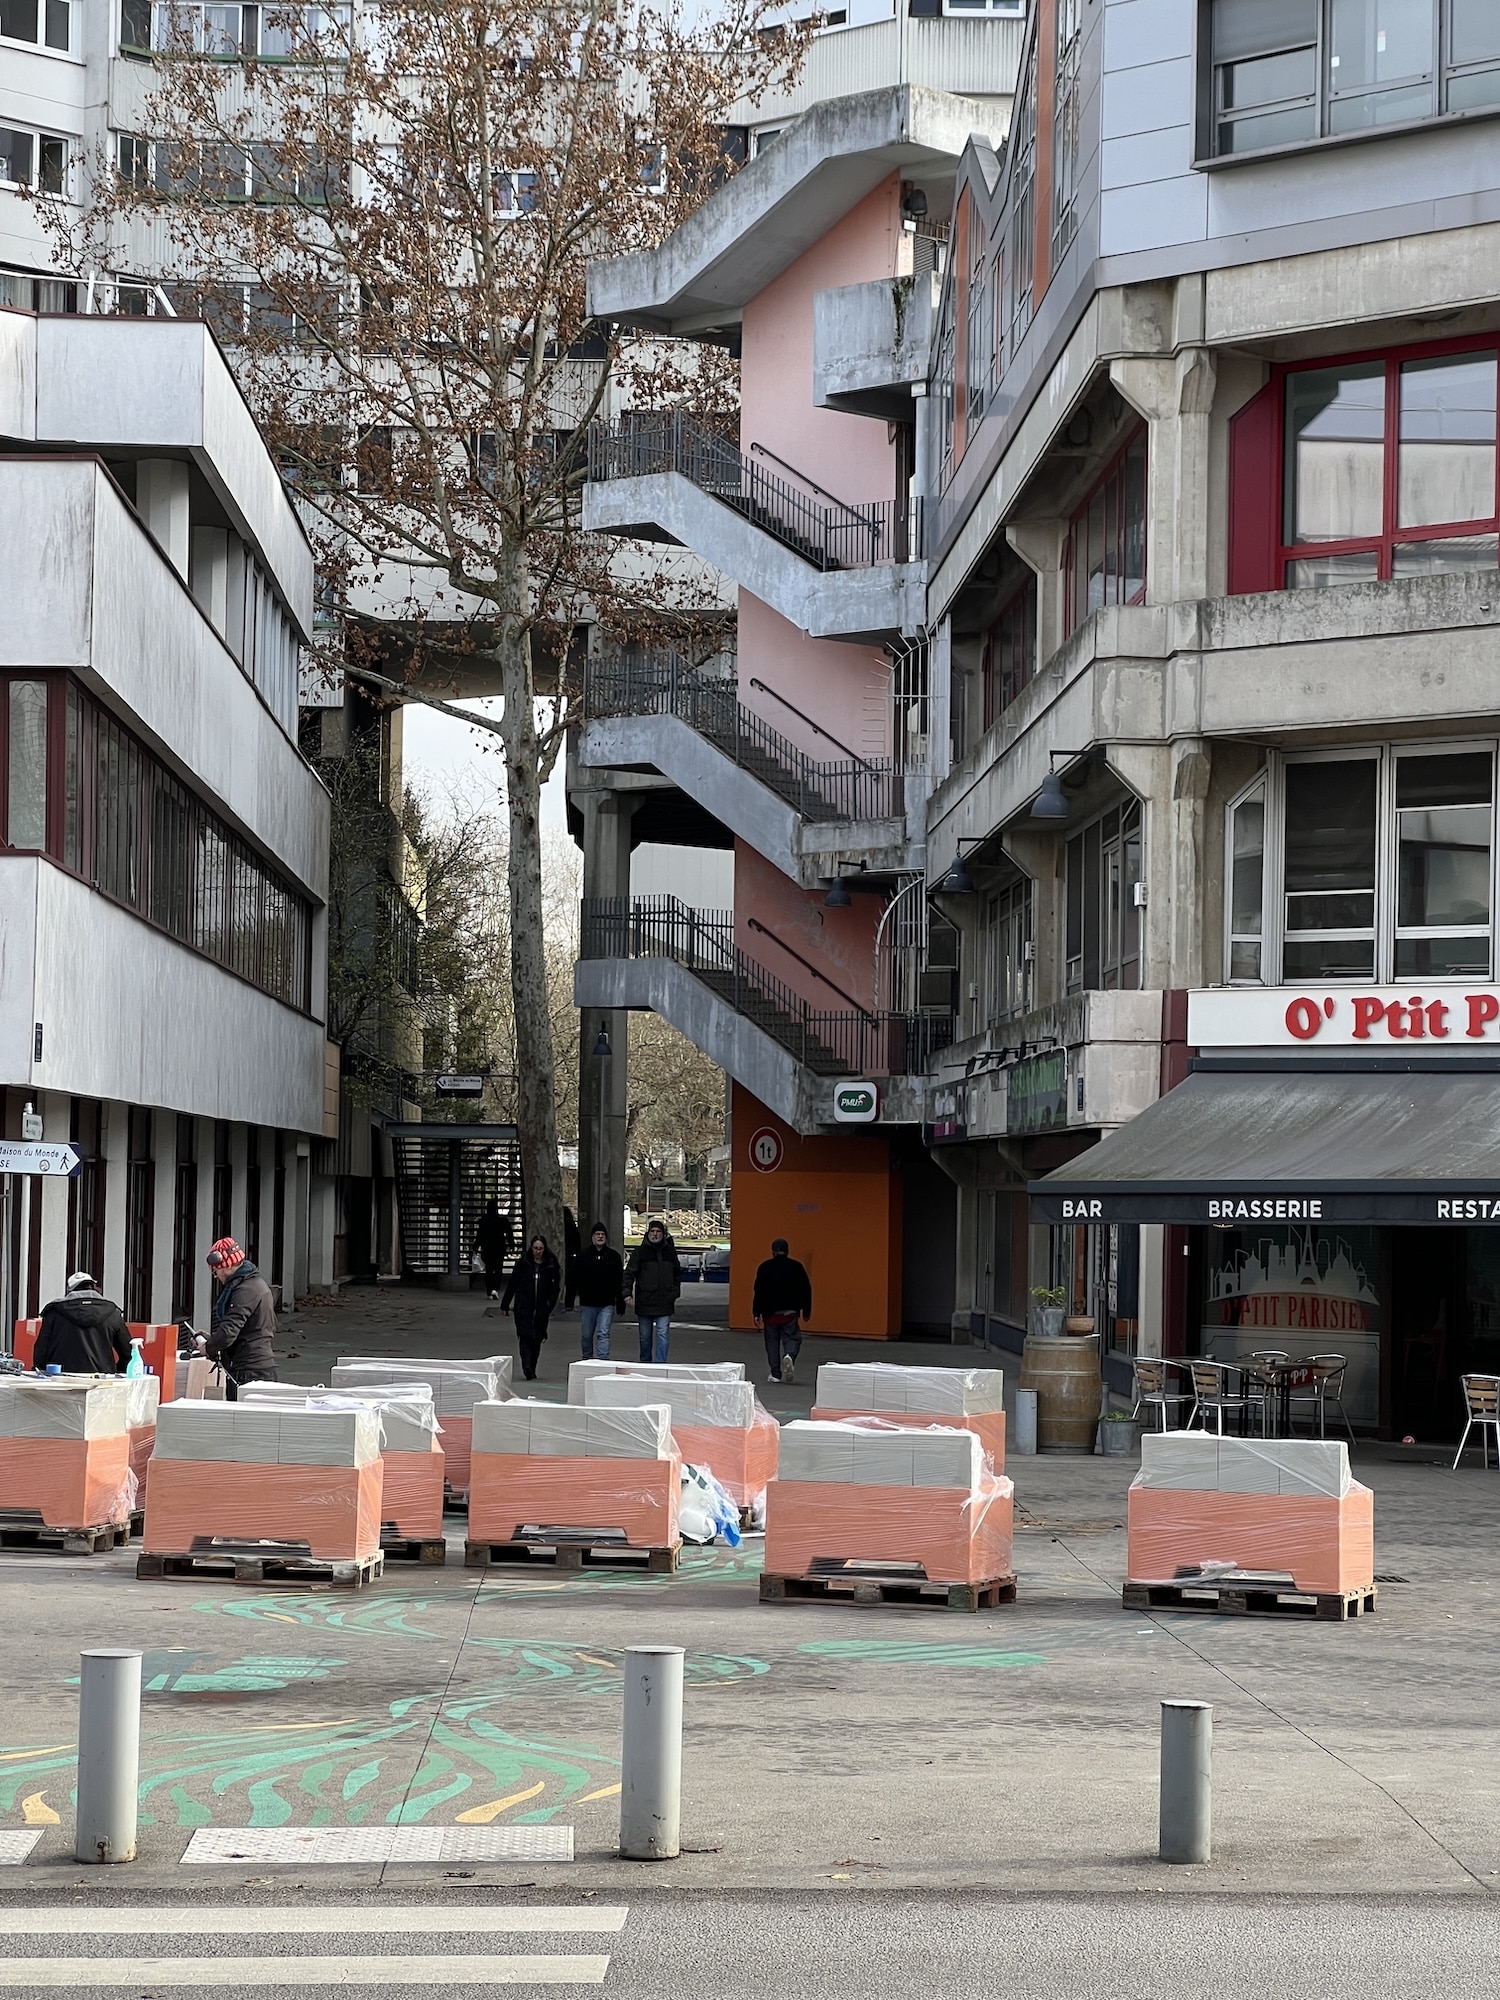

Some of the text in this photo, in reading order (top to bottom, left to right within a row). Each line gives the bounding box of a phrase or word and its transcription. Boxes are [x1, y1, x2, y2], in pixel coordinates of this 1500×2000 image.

[1285, 994, 1500, 1039] O' Ptit P
[840, 1098, 859, 1107] PMU
[24, 1148, 34, 1157] du
[34, 1148, 60, 1158] Monde
[1062, 1200, 1103, 1218] BAR
[1208, 1200, 1322, 1218] BRASSERIE
[1437, 1200, 1500, 1219] RESTA
[1287, 1296, 1371, 1330] PARISIEN
